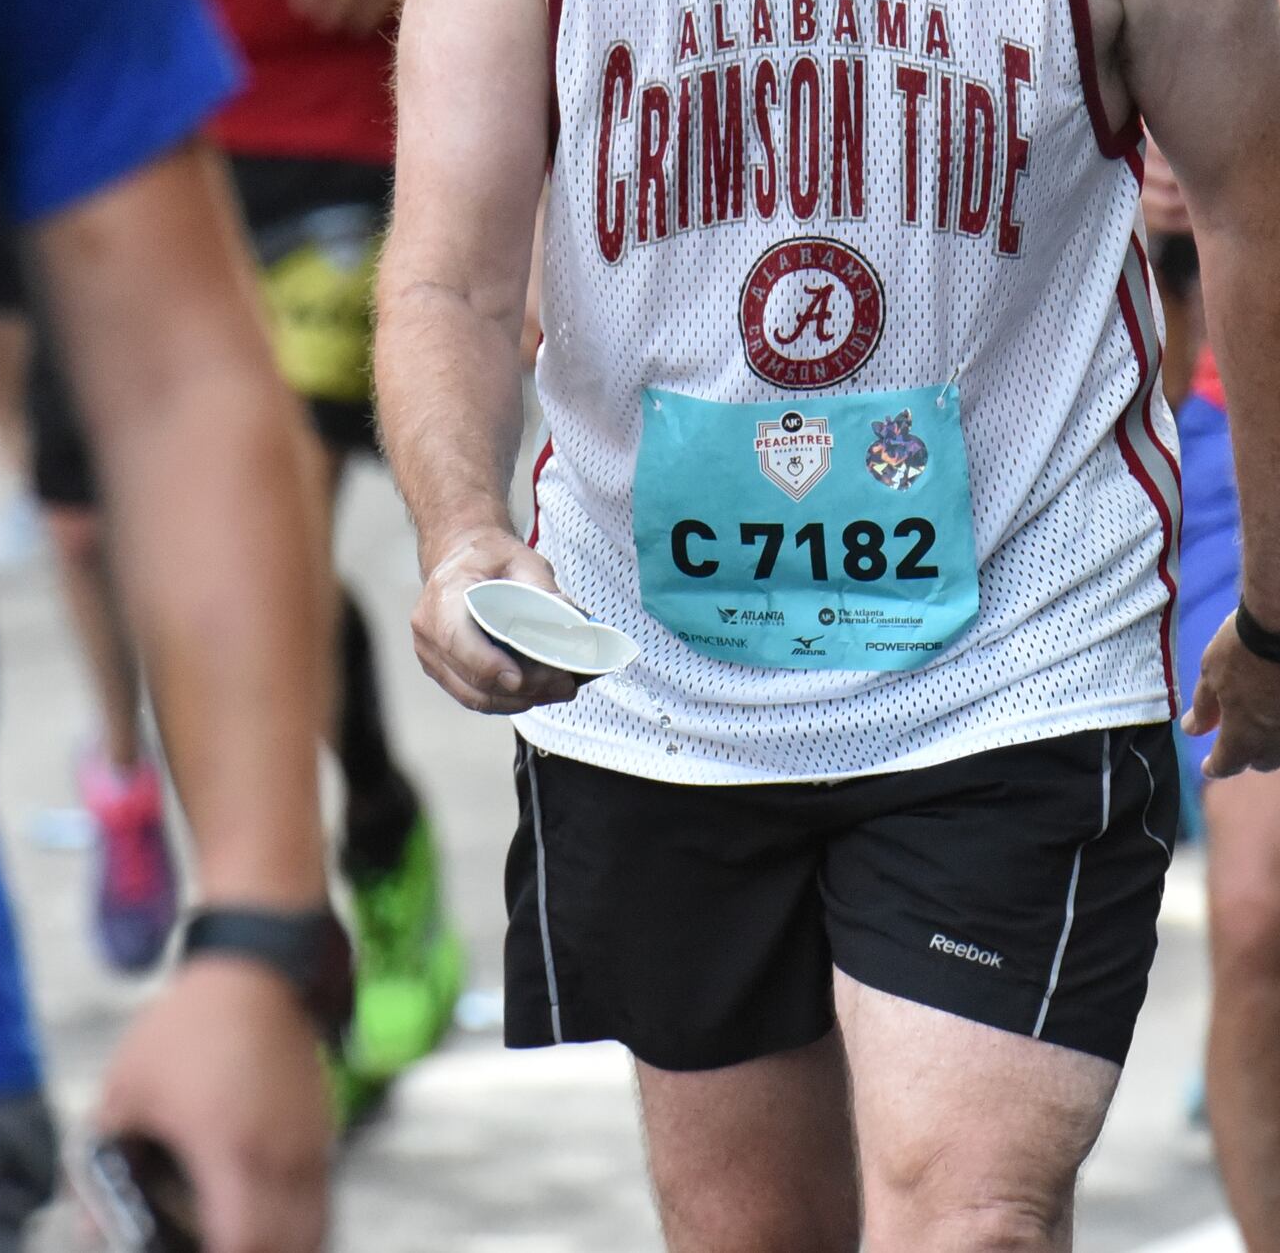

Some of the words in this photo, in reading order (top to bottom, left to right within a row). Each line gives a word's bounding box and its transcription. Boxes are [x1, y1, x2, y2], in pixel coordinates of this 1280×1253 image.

[890, 34, 1036, 259] TIDE
[751, 247, 872, 306] ALABAMA
[773, 283, 836, 345] A
[748, 324, 827, 381] CRIMSON
[832, 323, 874, 371] TIDE
[784, 418, 801, 428] AJC
[756, 435, 832, 449] PEACHTREE
[671, 519, 720, 578] C
[739, 517, 940, 582] 7182
[741, 611, 785, 620] ATLANTA
[838, 608, 852, 617] The
[854, 608, 884, 617] Atlanta
[838, 615, 924, 626] Journal-Constitution
[865, 642, 943, 652] POWERADE
[929, 933, 1004, 970] Reebok
